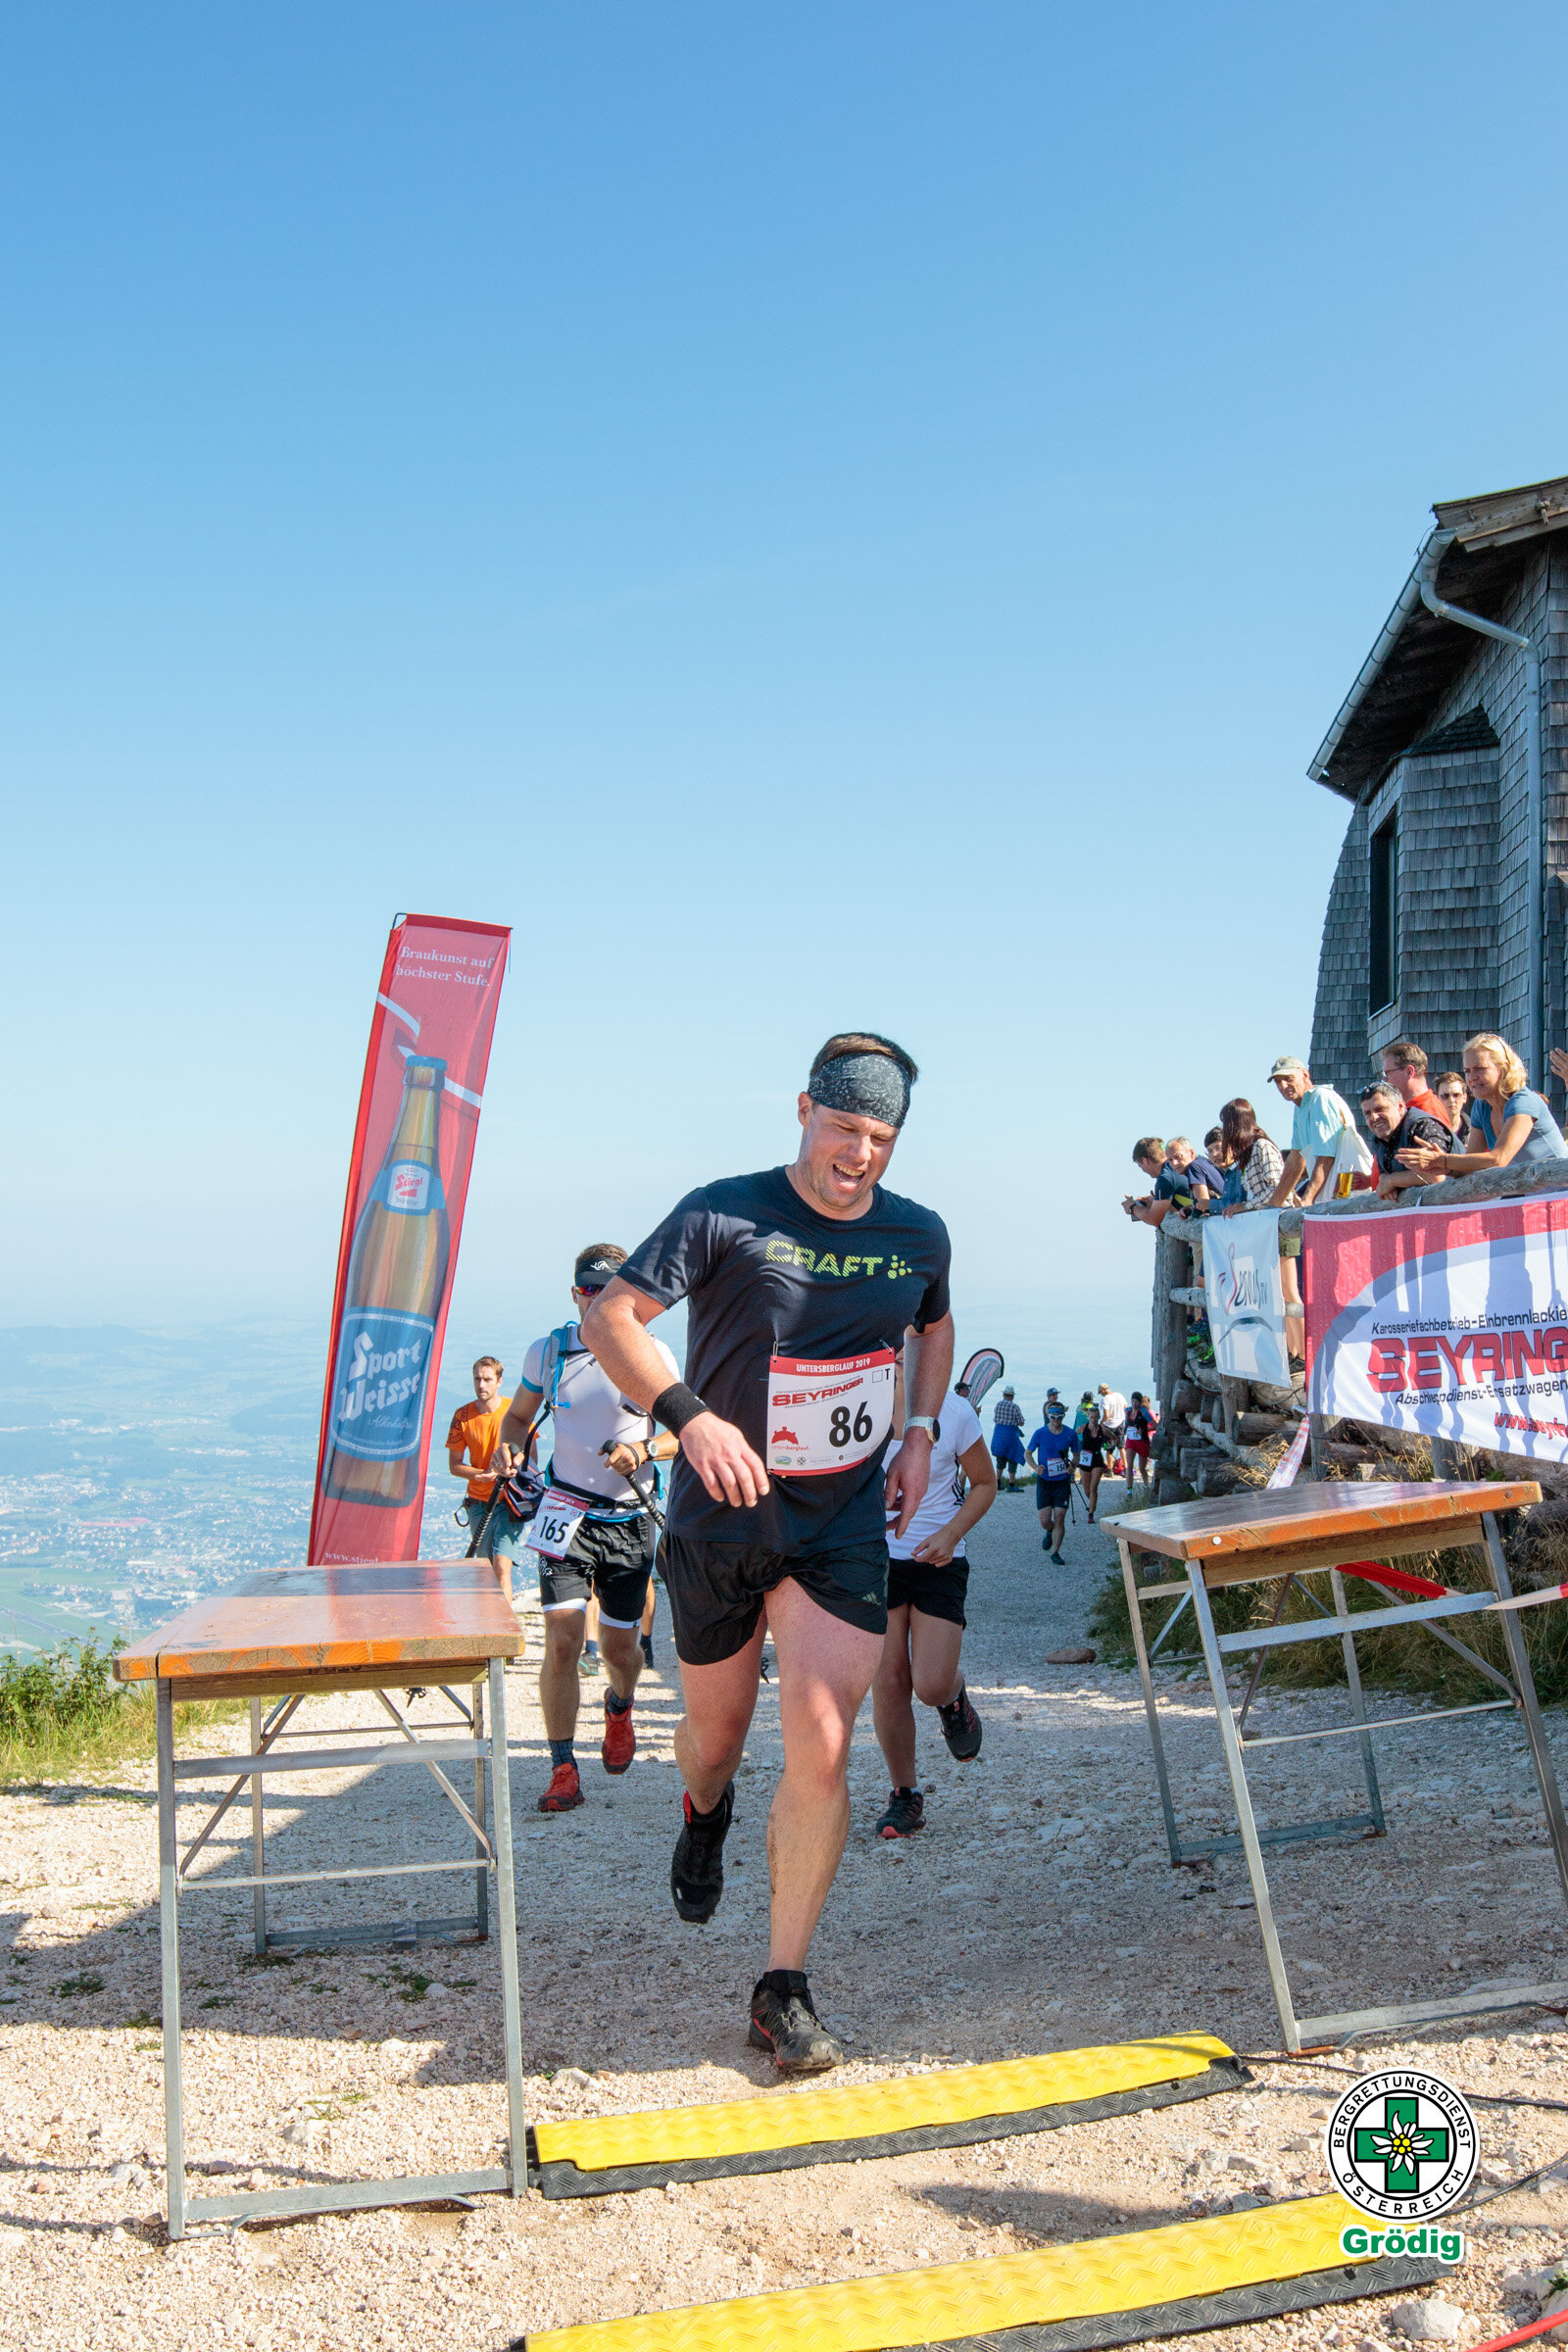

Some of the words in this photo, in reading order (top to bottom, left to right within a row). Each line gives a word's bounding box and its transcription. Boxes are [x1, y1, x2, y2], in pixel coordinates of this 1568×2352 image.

[401, 946, 467, 965] Braukunst
[470, 956, 495, 968] auf
[395, 964, 452, 981] höchster
[454, 970, 491, 987] Stufe.
[765, 1240, 884, 1277] CRAFT
[348, 1331, 421, 1382] Sport
[796, 1361, 855, 1373] UNTERSBERGLAUF
[856, 1357, 870, 1368] 2019
[1366, 1326, 1568, 1393] SEYRING
[885, 1368, 891, 1380] T
[337, 1371, 421, 1423] Weisse
[772, 1377, 863, 1407] SEYRINGER
[829, 1400, 873, 1448] 86
[539, 1515, 570, 1544] 165
